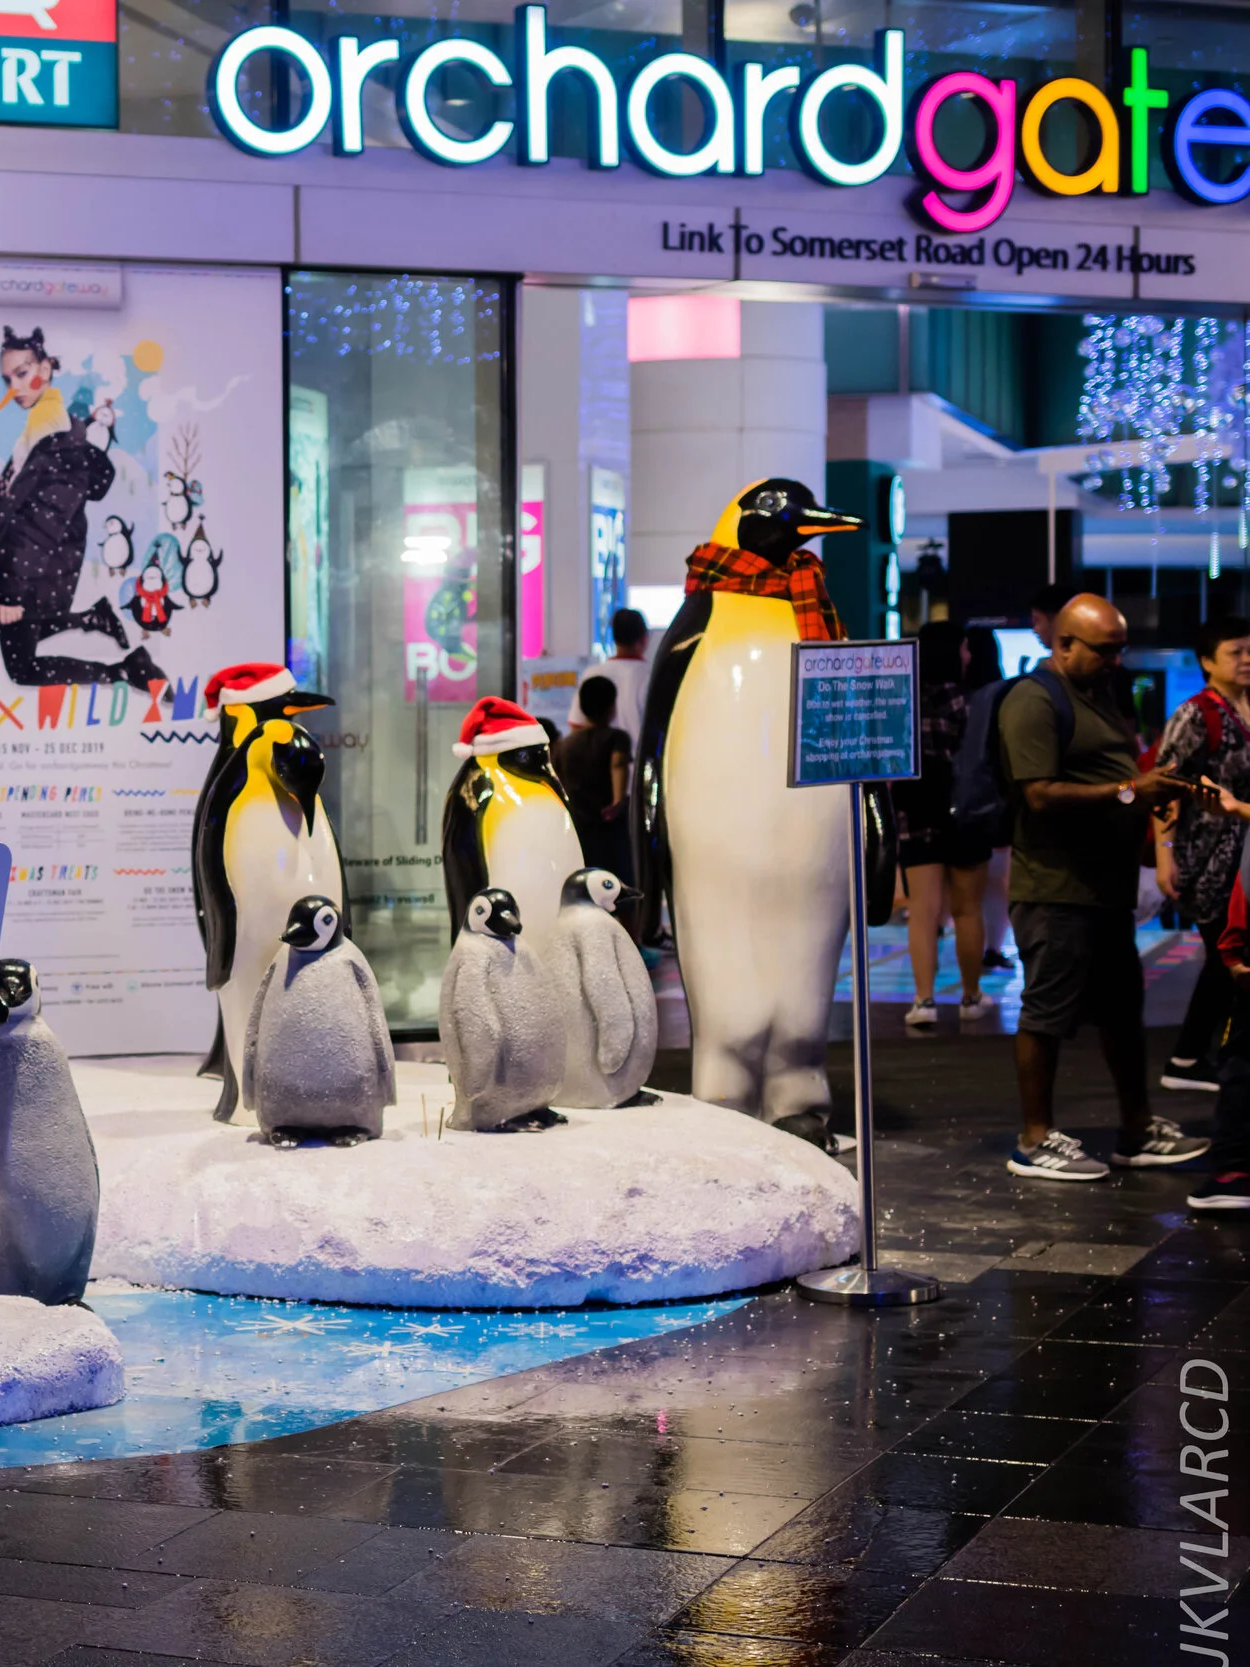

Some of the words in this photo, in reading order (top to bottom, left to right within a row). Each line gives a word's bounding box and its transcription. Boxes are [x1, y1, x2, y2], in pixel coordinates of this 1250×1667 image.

[662, 221, 724, 254] Link
[729, 224, 764, 255] To
[772, 227, 906, 262] Somerset
[916, 234, 984, 266] Road
[994, 239, 1068, 275] Open
[1076, 243, 1108, 271] 24
[1116, 246, 1196, 275] Hours
[805, 653, 909, 674] orchardgateway
[818, 681, 831, 692] Do
[832, 680, 848, 691] The
[850, 679, 874, 691] Snow
[875, 678, 895, 689] Walk
[38, 681, 129, 730] WILD
[831, 700, 844, 708] wet
[875, 698, 887, 706] the
[888, 698, 907, 706] snow
[825, 713, 844, 722] show
[845, 712, 852, 720] is
[11, 743, 30, 754] NOV
[44, 743, 55, 754] 25
[59, 742, 77, 754] DEC
[81, 742, 104, 754] 2019
[819, 737, 839, 748] Enjoy
[840, 738, 857, 748] your
[859, 735, 893, 745] Christmas
[840, 751, 848, 760] at
[0, 785, 57, 802] SPENDING
[64, 785, 102, 802] PERKS
[382, 855, 392, 866] of
[396, 856, 431, 867] Sliding
[51, 865, 99, 881] TREATS
